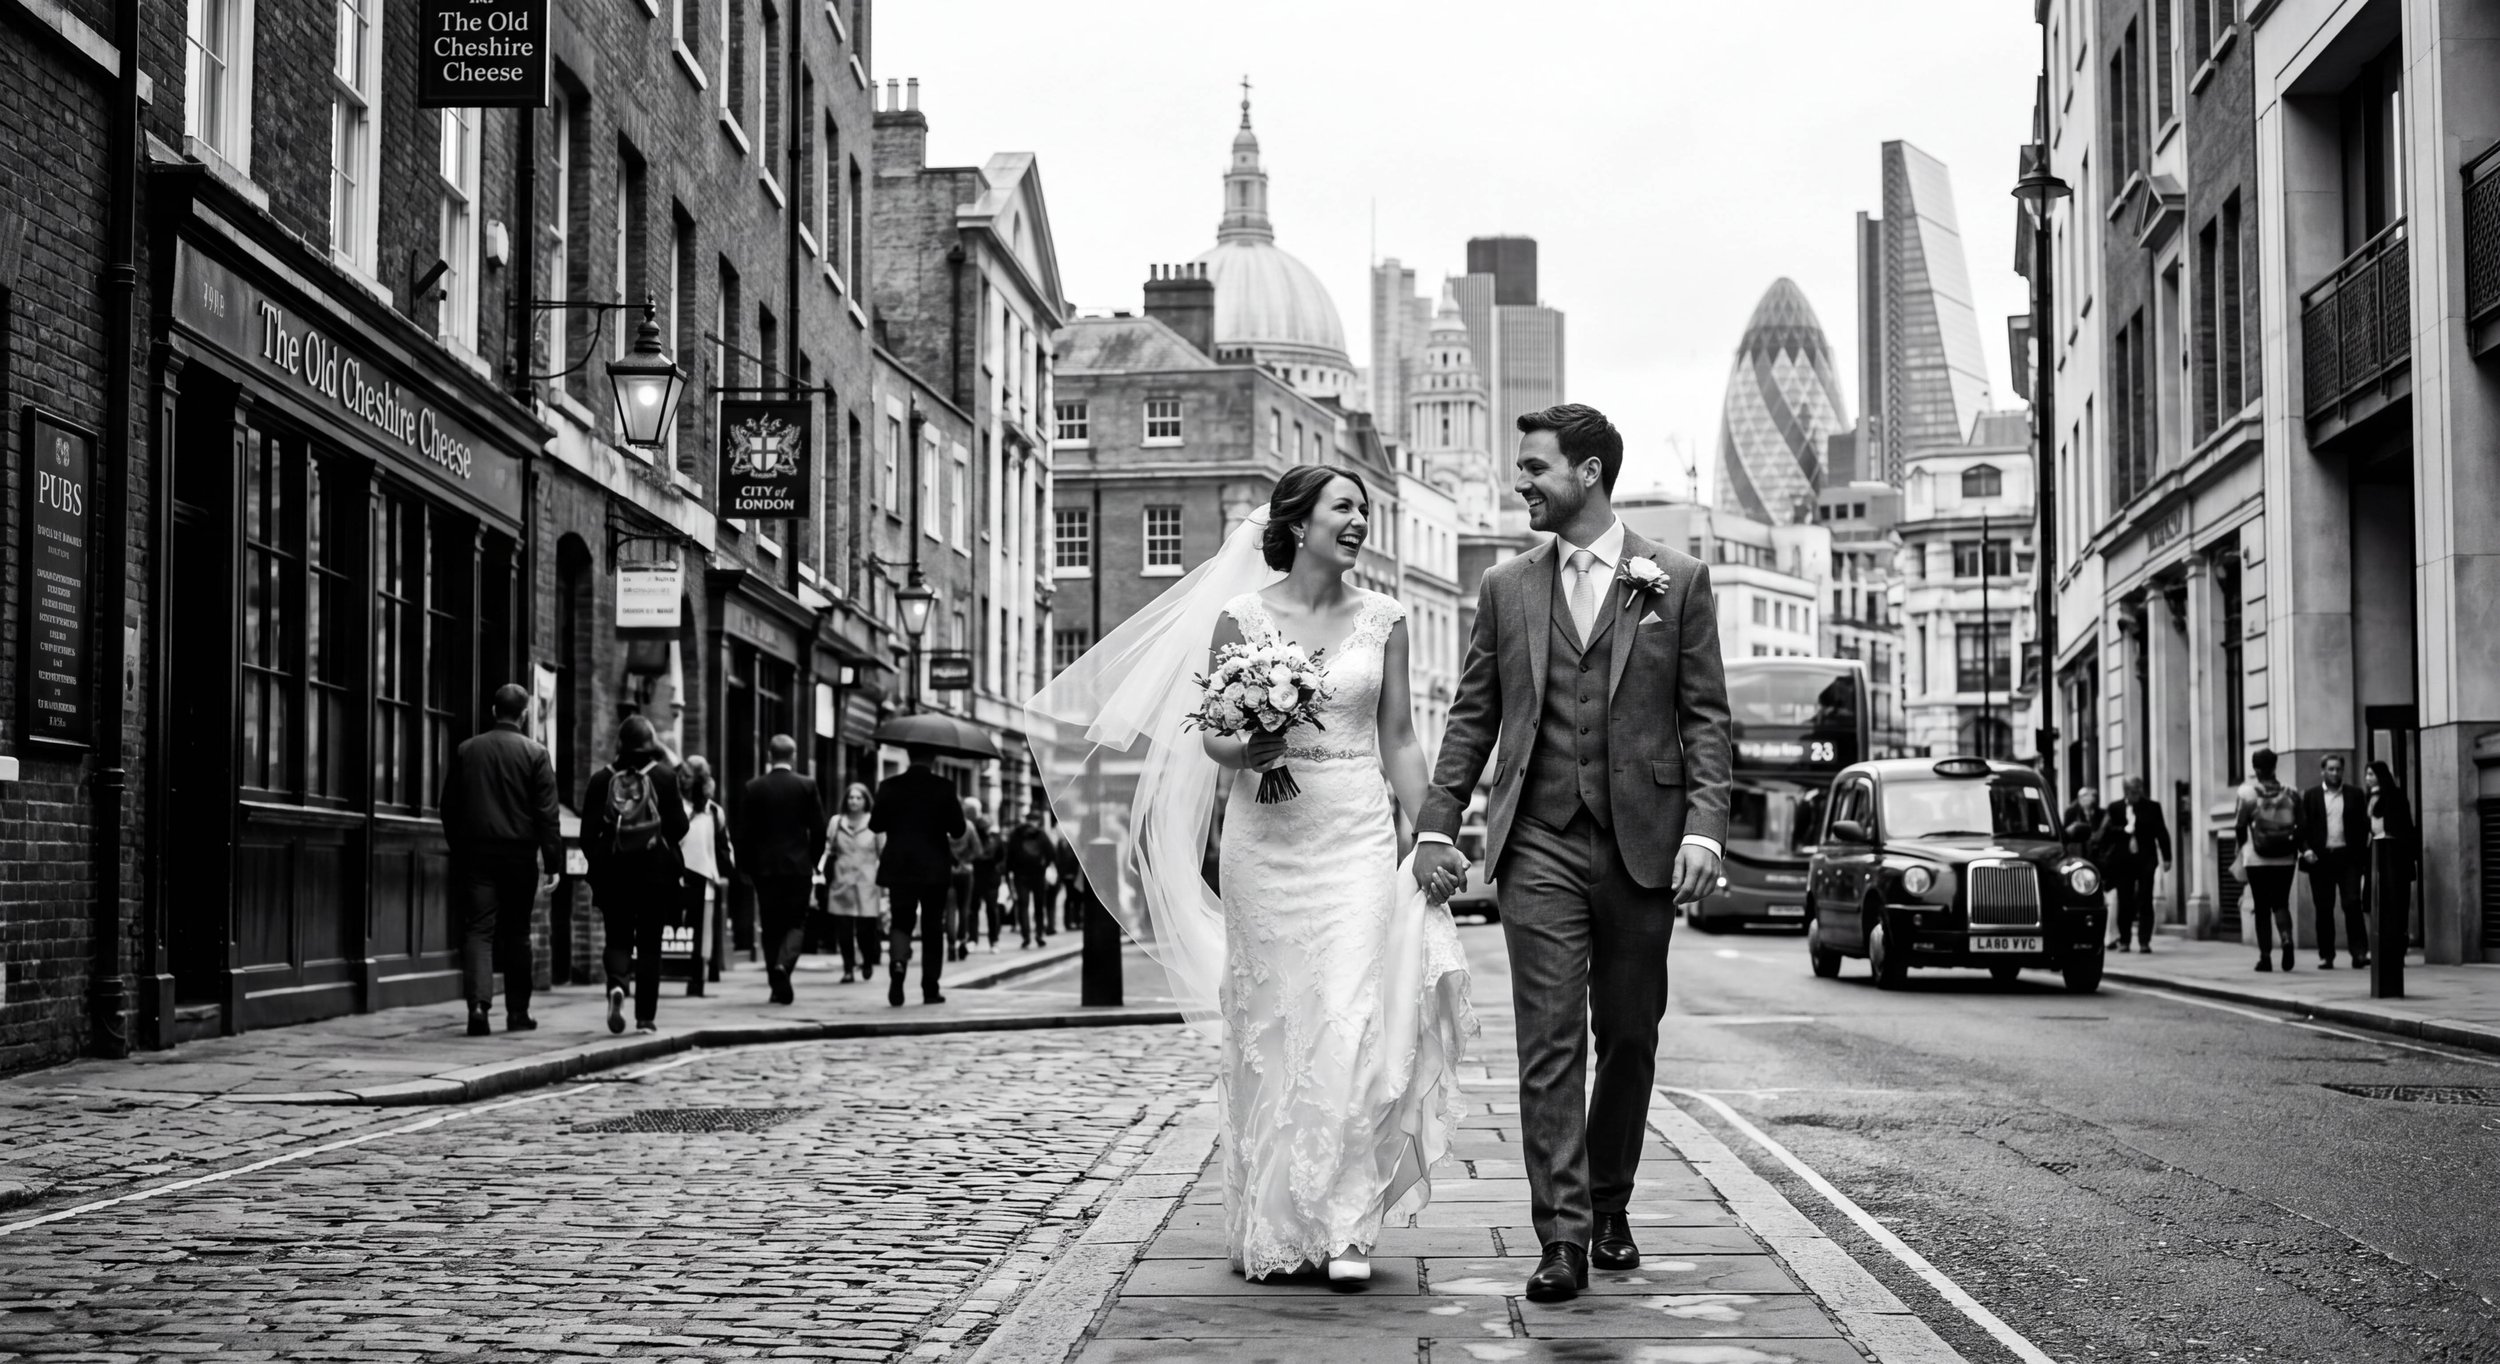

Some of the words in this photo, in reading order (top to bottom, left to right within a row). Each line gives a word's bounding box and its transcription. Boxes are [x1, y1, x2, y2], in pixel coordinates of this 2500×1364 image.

[438, 11, 482, 31] The
[488, 11, 528, 31] Old
[434, 36, 534, 57] Cheshire
[443, 61, 523, 82] Cheese
[261, 301, 299, 375] The
[305, 331, 337, 399] Old
[342, 358, 415, 447] Cheshire
[420, 407, 471, 479] Cheese
[38, 470, 82, 517] PUBS
[741, 485, 773, 497] CITY
[735, 498, 795, 510] LONDON
[1810, 741, 1834, 761] 23
